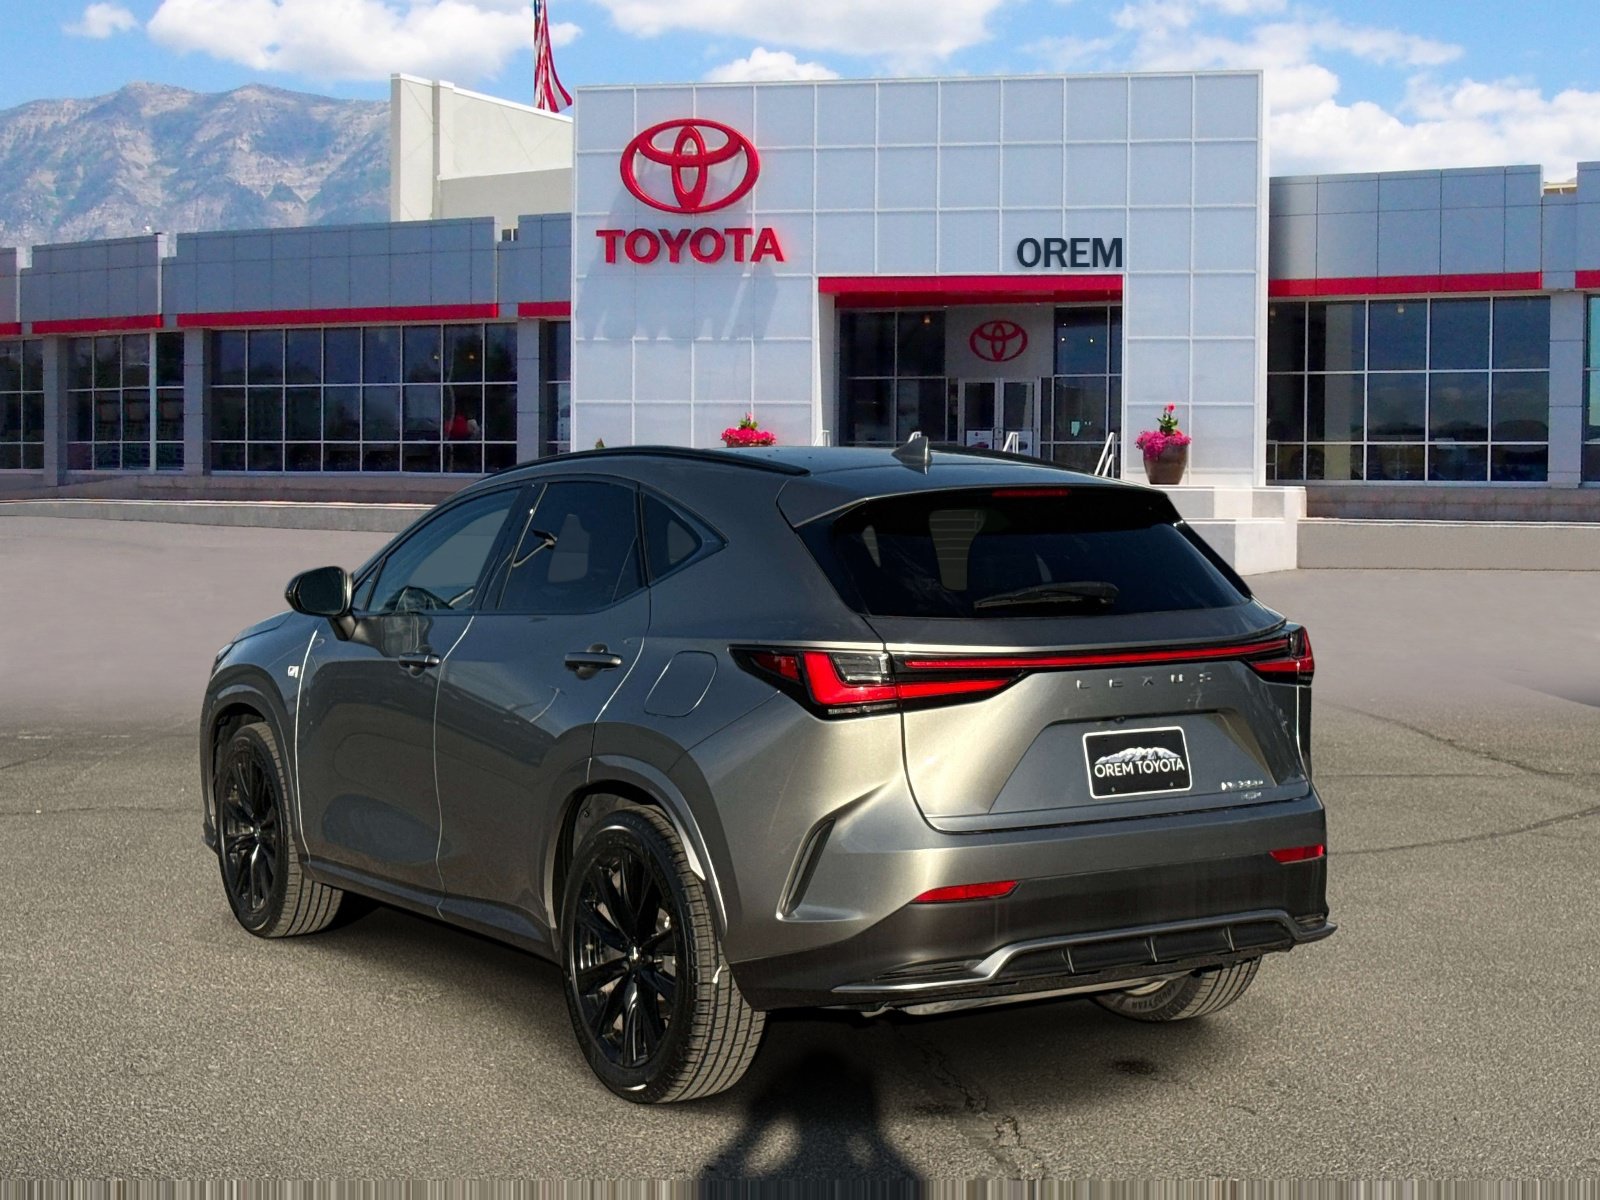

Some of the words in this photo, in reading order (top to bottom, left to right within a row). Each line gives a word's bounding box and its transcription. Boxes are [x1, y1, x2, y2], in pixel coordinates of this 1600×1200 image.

[596, 227, 785, 264] TOYOTA
[1016, 237, 1123, 268] OREM
[1075, 671, 1213, 691] LEXUS
[1094, 761, 1135, 778] OREM
[1136, 757, 1186, 774] TOYOTA
